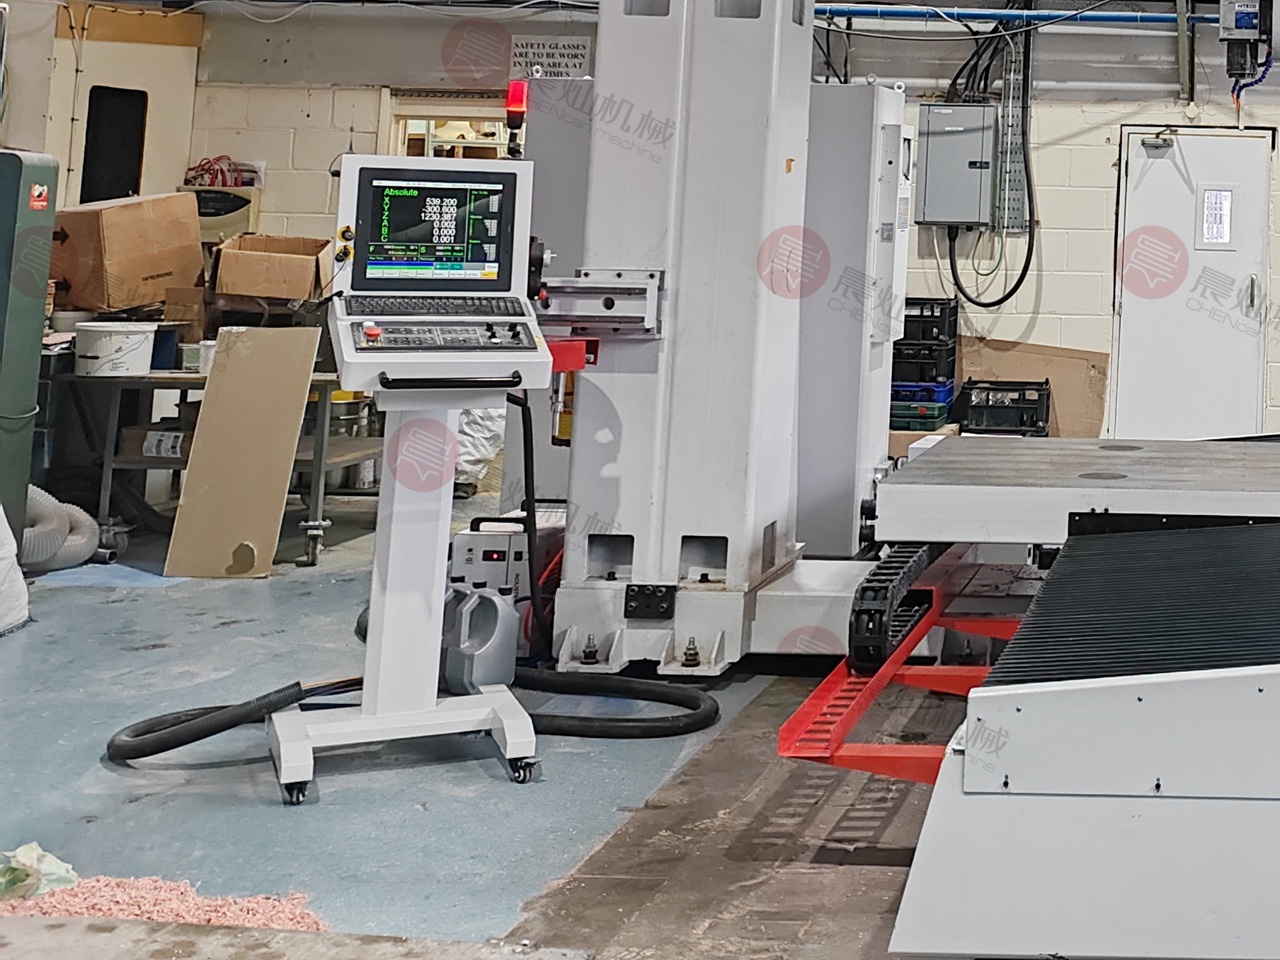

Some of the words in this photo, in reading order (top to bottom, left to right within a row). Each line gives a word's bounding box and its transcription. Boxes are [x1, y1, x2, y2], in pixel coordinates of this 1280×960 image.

[514, 42, 546, 50] SAFETY
[384, 188, 418, 196] Absolute
[426, 198, 458, 206] 539.200
[382, 212, 389, 220] Z
[434, 220, 456, 228] 0.002
[432, 228, 456, 236] 0.000
[432, 236, 454, 244] 0.001
